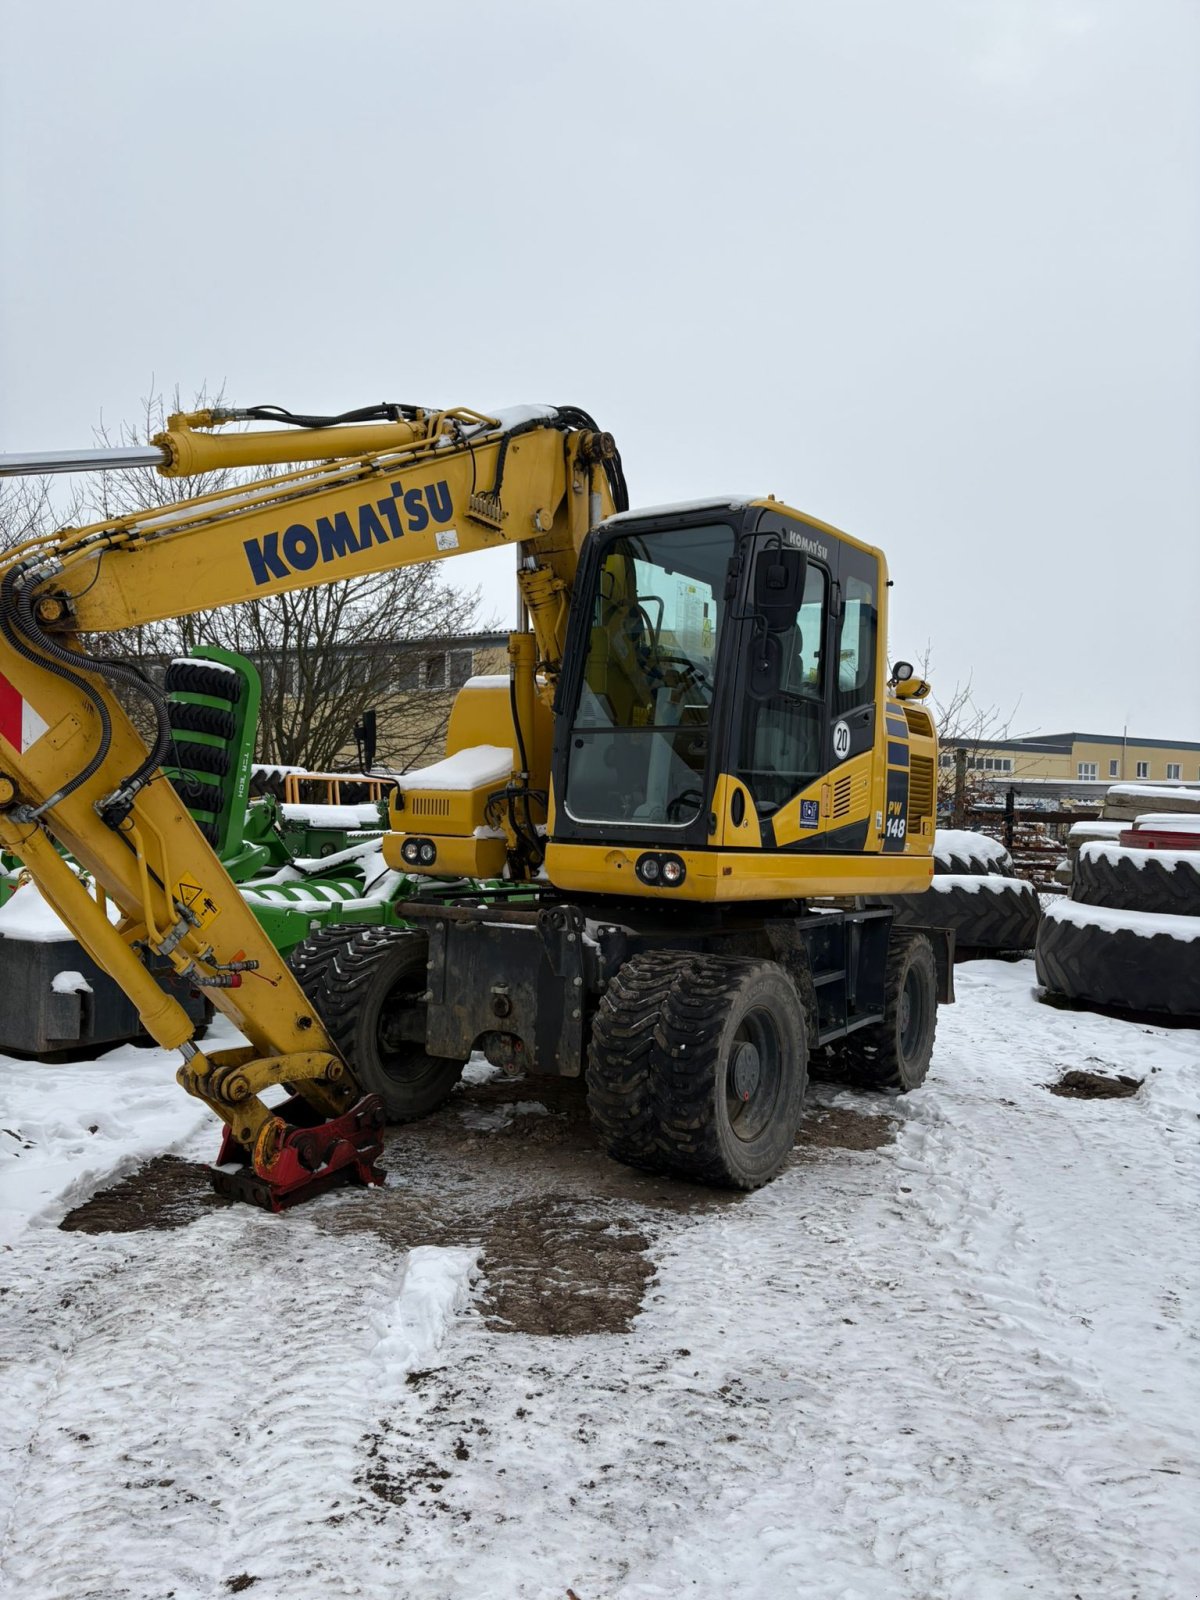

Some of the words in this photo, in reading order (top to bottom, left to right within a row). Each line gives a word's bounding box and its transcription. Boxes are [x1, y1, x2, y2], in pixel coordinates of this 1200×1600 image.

[243, 480, 454, 586] KOMATSU
[789, 530, 828, 560] KOMATSU
[836, 727, 848, 752] 20
[887, 801, 903, 816] PW
[886, 818, 906, 838] 148
